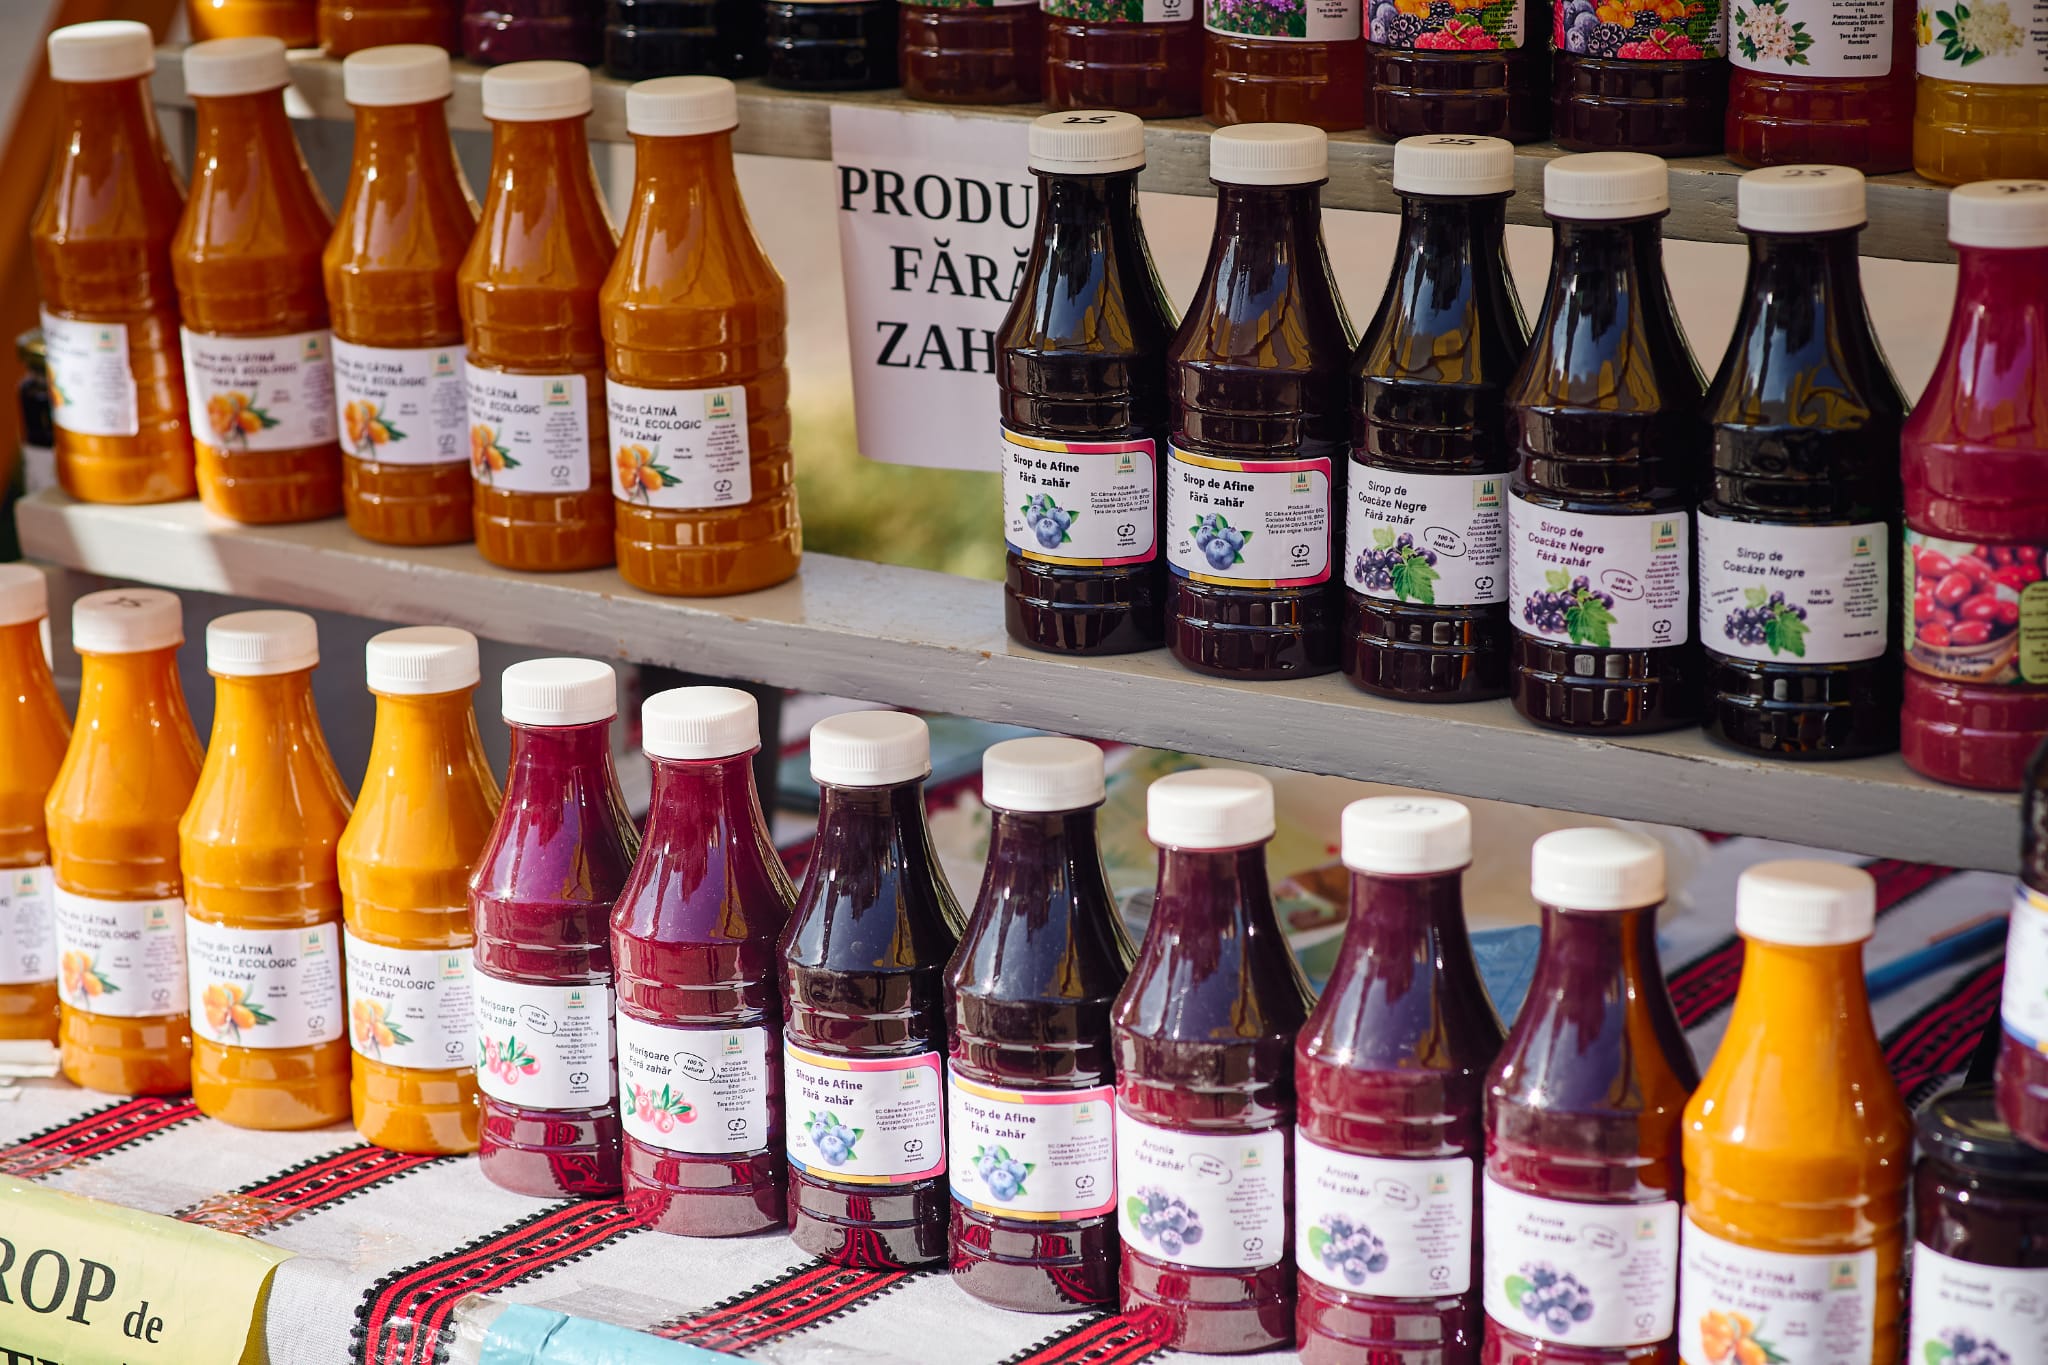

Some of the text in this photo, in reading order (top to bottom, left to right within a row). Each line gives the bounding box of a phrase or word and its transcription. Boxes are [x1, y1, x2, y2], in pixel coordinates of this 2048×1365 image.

[1062, 114, 1117, 125] 25
[645, 419, 703, 430] ECOLOGIC
[1013, 453, 1080, 473] Sirop de Afine
[1183, 473, 1255, 493] Sirop de Afine
[1368, 480, 1408, 497] Sirop de
[1394, 500, 1428, 514] Negre
[1540, 521, 1584, 538] Sirop de
[1569, 541, 1605, 555] Negre
[1737, 547, 1784, 562] Sirop de
[1769, 566, 1805, 580] Negre
[238, 958, 297, 969] ECOLOGIC
[379, 976, 436, 991] ECOLOGIC
[796, 1068, 863, 1090] Sirop de Afine
[964, 1101, 1036, 1124] Sirop de Afine
[123, 1300, 163, 1344] de
